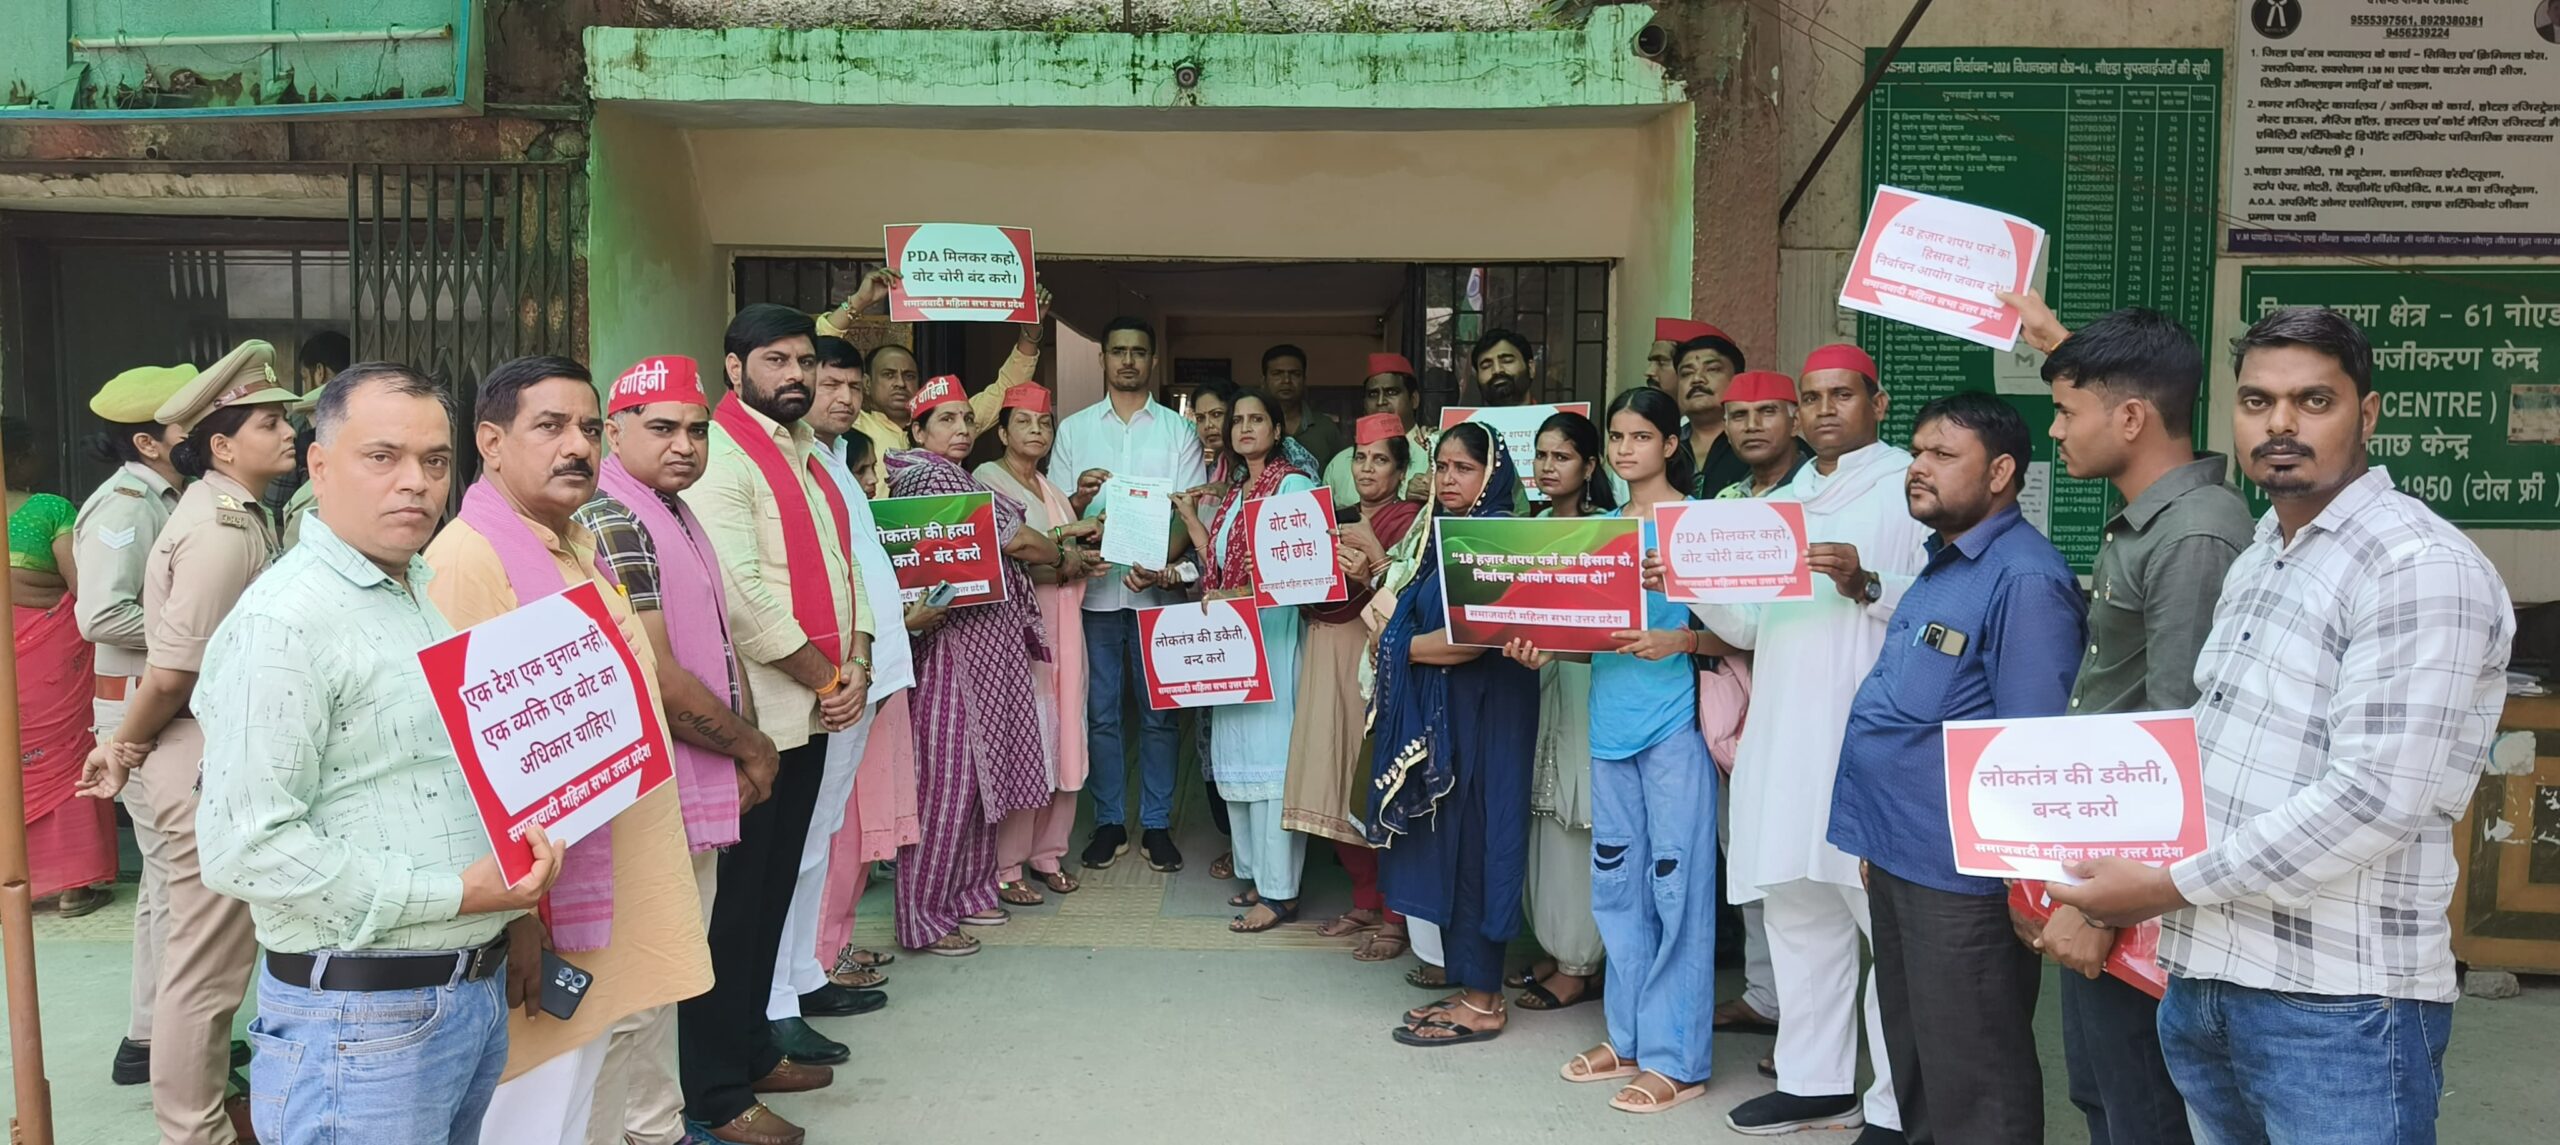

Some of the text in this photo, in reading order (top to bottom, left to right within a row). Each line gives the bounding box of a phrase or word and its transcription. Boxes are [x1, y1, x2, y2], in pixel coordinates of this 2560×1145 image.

[2351, 15, 2483, 27] 9555397561, 8929380381
[2386, 28, 2449, 38] 9456239224
[1918, 61, 1952, 74] सामान्य
[2095, 58, 2121, 76] नोएडा
[2177, 58, 2190, 75] की
[907, 248, 1019, 266] PDA मिलकर कहो,
[913, 268, 1017, 284] वोट चोरी बंद करो।
[2389, 296, 2430, 327] क्षेत्र
[2464, 304, 2493, 326] 61
[2372, 339, 2542, 372] पंजीकरण केन्द्र
[620, 360, 669, 396] वाहिनी
[918, 377, 950, 403] वाहिनी
[2382, 392, 2482, 418] CENTRE
[2421, 426, 2472, 460] केन्द्र
[2401, 475, 2453, 502] 1950
[2518, 472, 2546, 504] फ्री
[1269, 509, 1311, 531] वोट चोर,
[877, 521, 975, 544] ोकतंत्र की हत्या
[1677, 525, 1790, 544] PDA मिलकर कहो,
[892, 543, 981, 568] करो बंद करो
[1271, 538, 1318, 562] गद्दी छोड़!
[1507, 554, 1534, 566] शपथ
[1537, 552, 1557, 566] पत्रों
[1561, 555, 1576, 566] का
[1579, 553, 1615, 568] हिसाब
[1618, 553, 1634, 568] दो,
[1681, 548, 1788, 564] वोट चोरी बंद करो।
[1473, 568, 1514, 583] निर्वाचन
[1517, 570, 1552, 584] आयोग
[1555, 574, 1587, 584] जवाब
[1470, 609, 1623, 625] समाजवादी महिला सभा उत्तर प्रदेश
[1155, 631, 1194, 648] लोकतंत्र
[1198, 628, 1212, 642] की
[1184, 649, 1226, 666] बन्द करो
[464, 681, 492, 712] एक
[490, 668, 519, 696] देश
[518, 660, 545, 686] एक
[545, 639, 581, 676] चुनाव
[481, 664, 618, 751] एक व्यक्ति एक वोट का
[520, 707, 617, 775] अधिकार चाहिए।
[559, 781, 592, 809] महिला
[588, 768, 612, 791] सभा
[611, 756, 632, 778] उत्तर
[630, 742, 652, 768] प्रदेश
[1978, 759, 2168, 787] लोकतंत्र की डकैती,
[2032, 795, 2118, 819] बन्द करो
[1974, 842, 2184, 861] समाजवादी महिला सभा उत्तर प्रदेश
